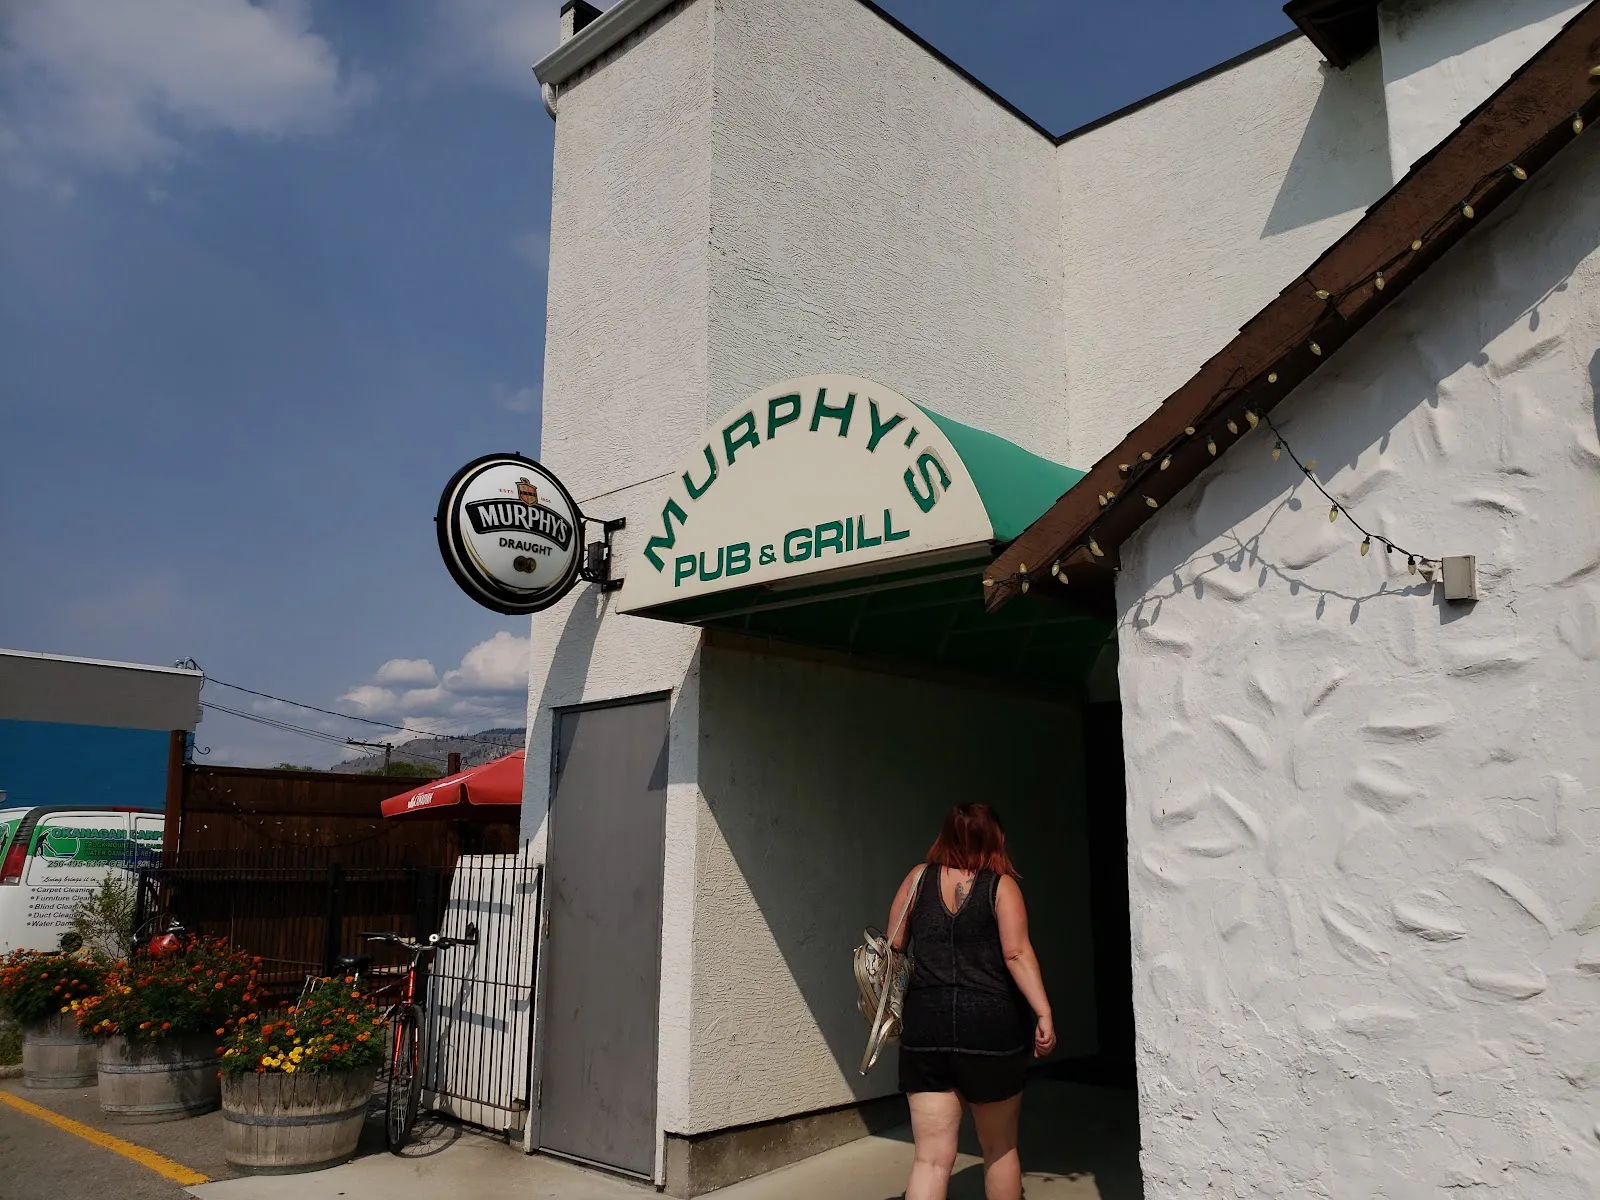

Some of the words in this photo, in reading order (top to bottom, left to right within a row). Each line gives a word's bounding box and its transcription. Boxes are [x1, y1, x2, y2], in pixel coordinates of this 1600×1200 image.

[643, 387, 951, 573] MURPHY'S
[498, 537, 553, 557] DRAUGHT
[674, 541, 751, 587] PUB
[758, 543, 777, 566] &
[783, 508, 910, 567] GRILL
[51, 827, 127, 840] OKANAGAN
